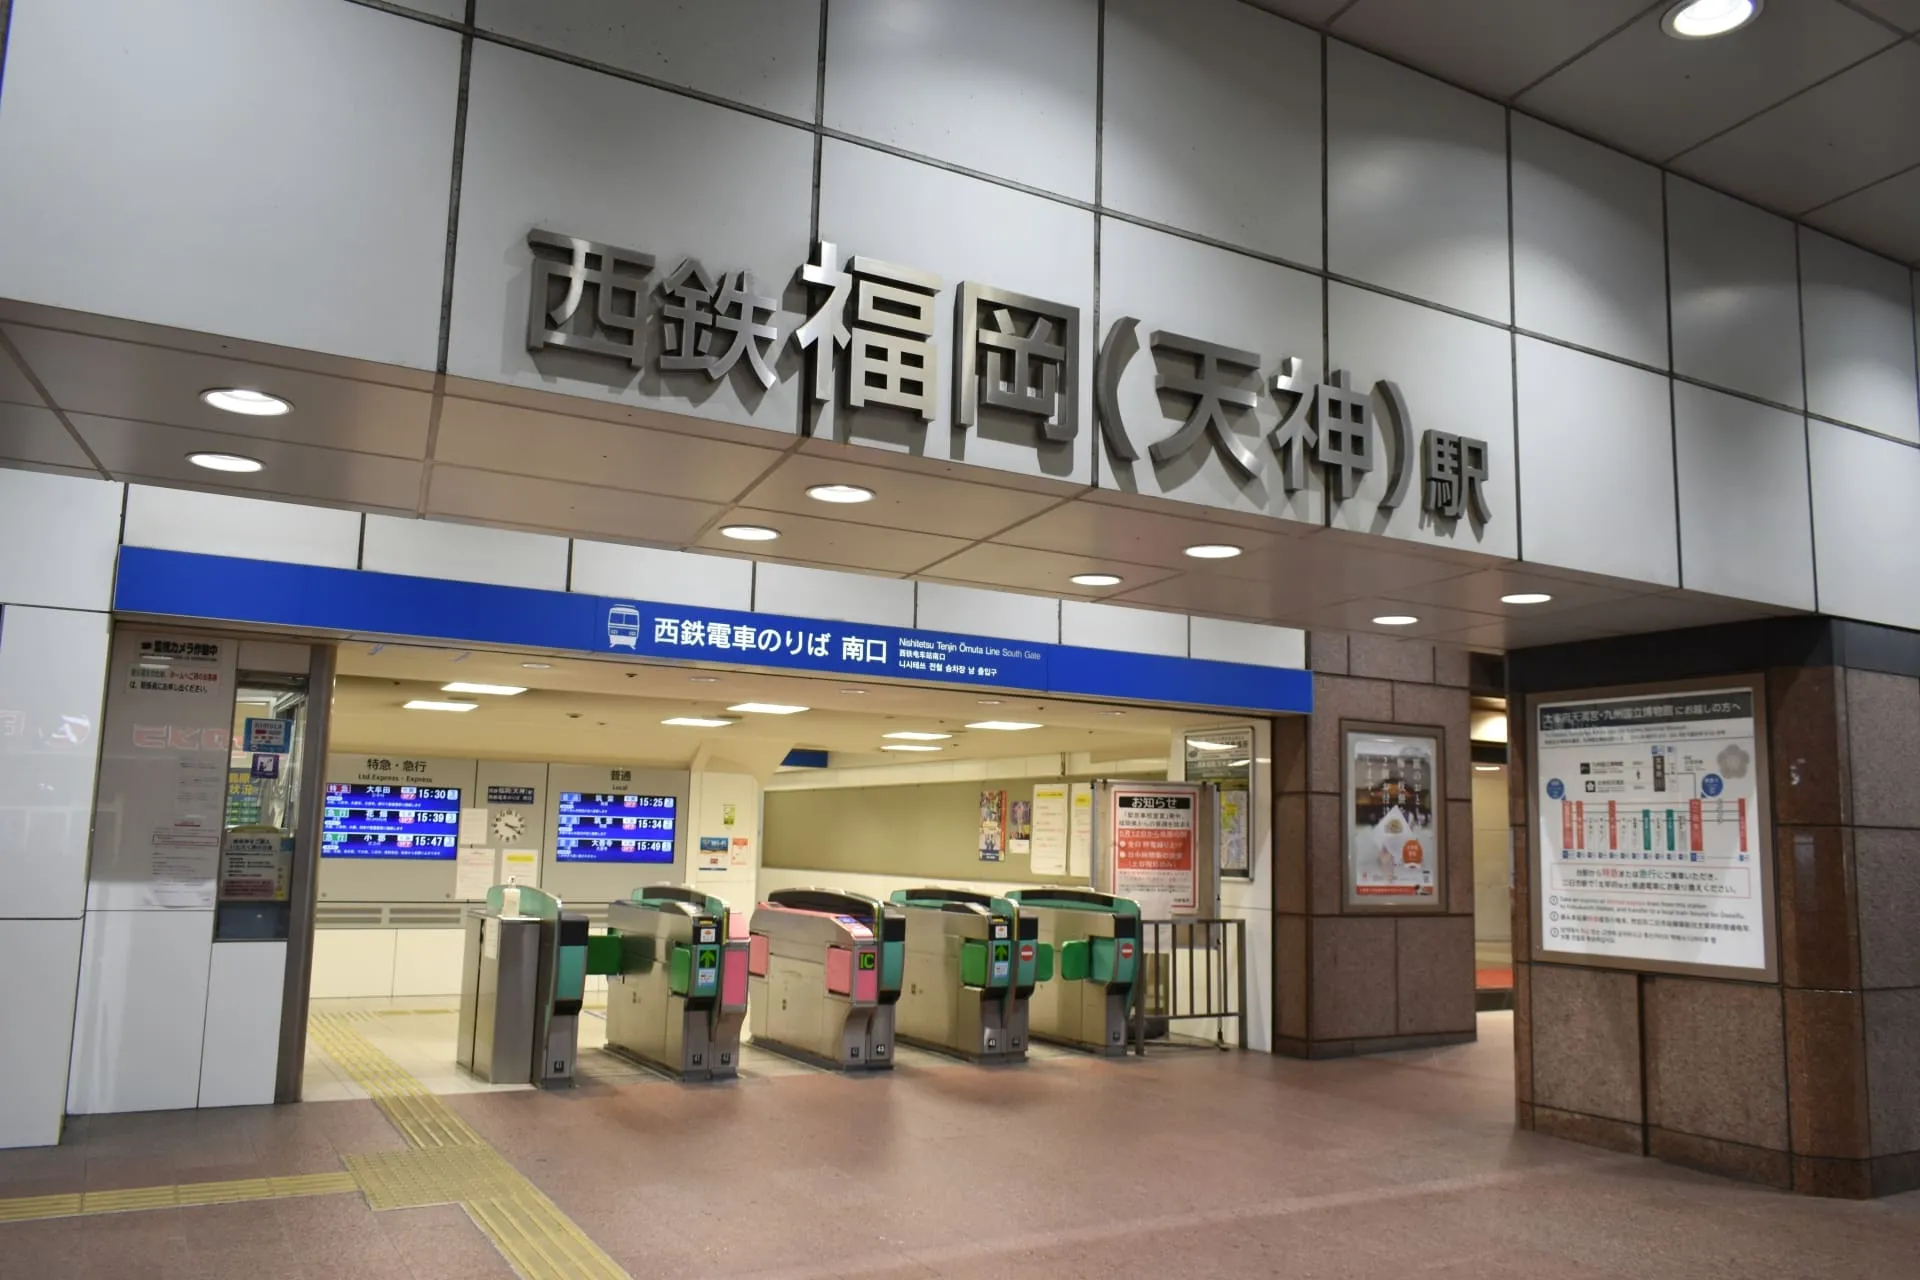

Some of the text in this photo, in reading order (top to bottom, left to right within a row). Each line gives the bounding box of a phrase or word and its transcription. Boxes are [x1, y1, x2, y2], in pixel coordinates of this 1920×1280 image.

[527, 228, 1494, 525] 西鉄福岡(天神)駅
[654, 617, 887, 664] 西鉄電車のりば 南口
[899, 637, 934, 649] Nishitetsu
[937, 641, 957, 652] Tenjin
[985, 646, 1000, 656] Line
[1002, 648, 1022, 659] South
[1024, 650, 1041, 660] Gate
[418, 789, 446, 799] 15:30
[639, 797, 663, 807] 15:25
[1131, 797, 1178, 809] お知らせ
[417, 813, 445, 823] 15:39
[638, 819, 662, 829] 15:34
[415, 837, 443, 846] 15:47
[637, 841, 661, 851] 15:49
[860, 953, 874, 969] IC
